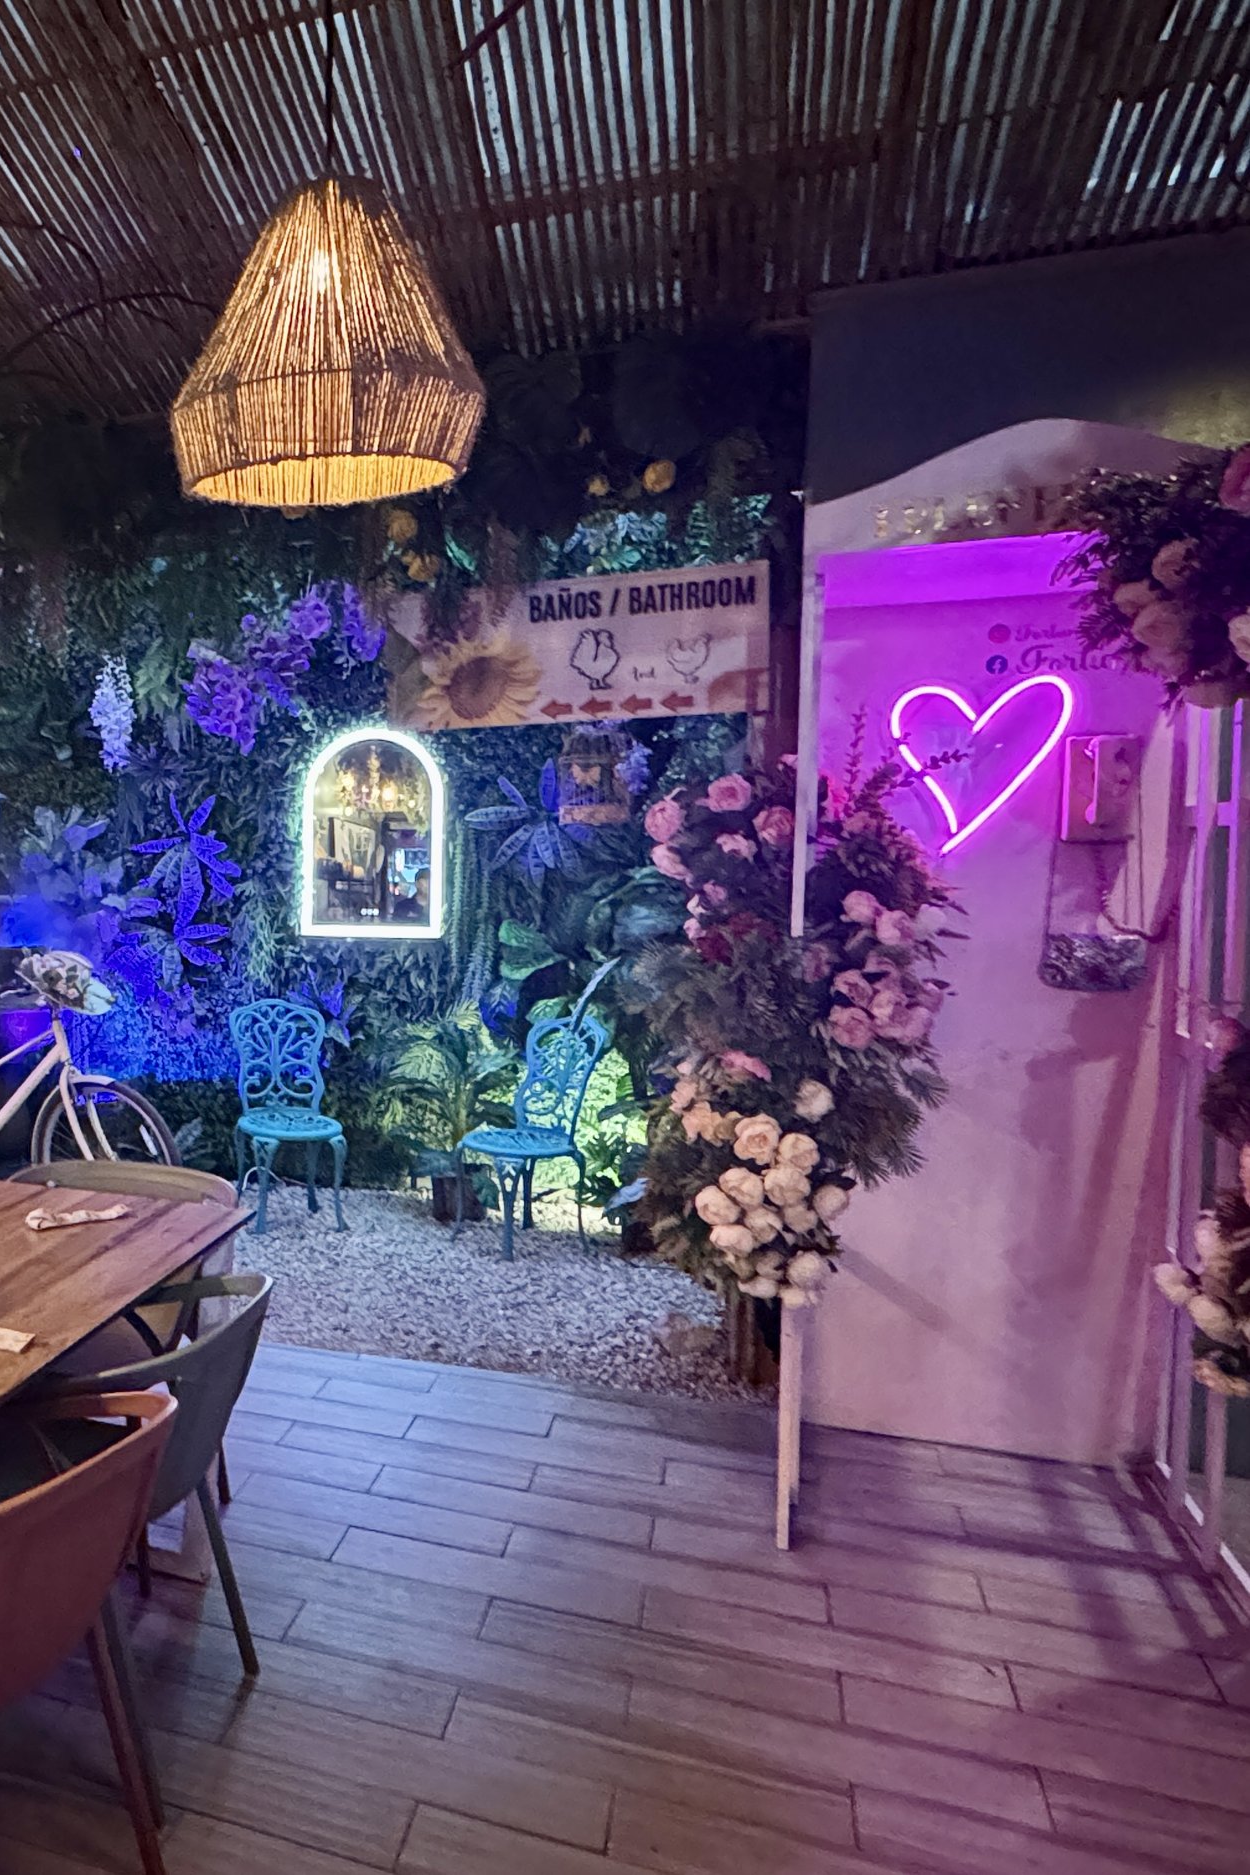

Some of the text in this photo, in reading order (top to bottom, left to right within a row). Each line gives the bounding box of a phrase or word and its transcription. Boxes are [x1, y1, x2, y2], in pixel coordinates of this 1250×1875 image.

[529, 576, 756, 623] BAÑOS / BATHROOM
